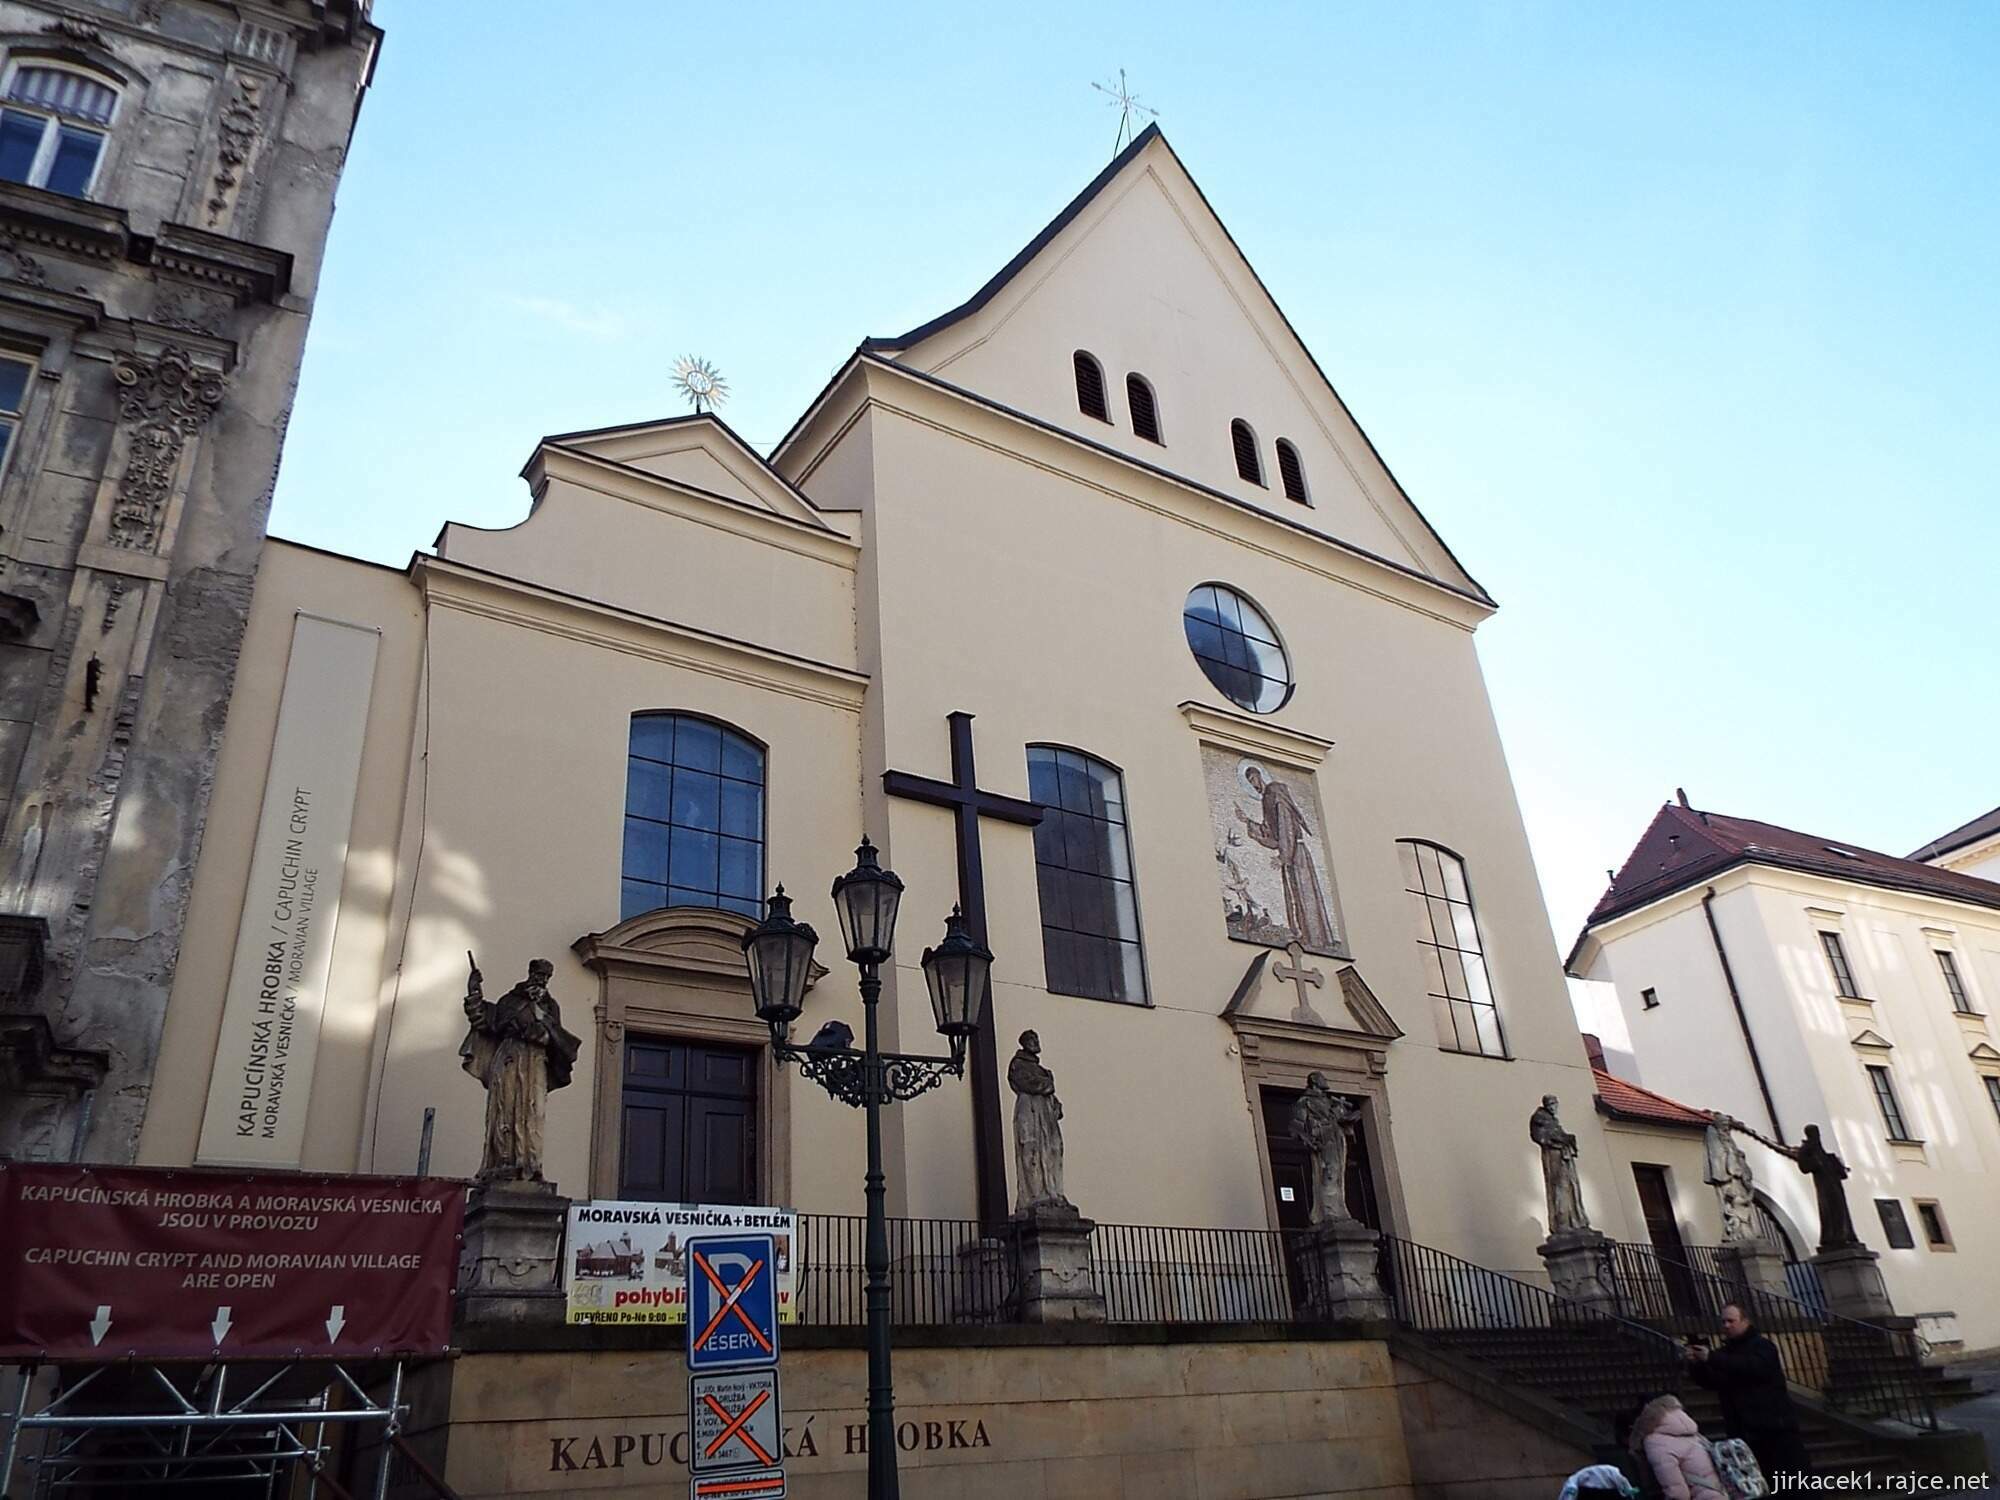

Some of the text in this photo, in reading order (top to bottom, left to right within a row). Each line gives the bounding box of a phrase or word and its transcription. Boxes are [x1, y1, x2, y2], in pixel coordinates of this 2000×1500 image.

[237, 1022, 272, 1138] KAPUCÍNSKÁ
[258, 940, 287, 1014] HROBKA
[274, 839, 303, 921] CAPUCHIN
[290, 786, 312, 834] CRYPT
[262, 1062, 286, 1138] MORAVSKÁ
[276, 995, 297, 1059] VESNIČKA
[288, 918, 309, 982] MORAVIAN
[300, 867, 318, 913] VILLAGE
[20, 1184, 443, 1213] KAPUCÍNSKÁ HROBKA A MORAVSKÁ VESNIČKA
[158, 1213, 319, 1231] JSOU V PROVOZU
[578, 1207, 661, 1225] MORAVSKÁ
[25, 1247, 421, 1270] CAPUCHIN CRYPT AND MORAVIAN VILLAGE
[181, 1272, 276, 1288] ARE OPEN
[615, 1285, 687, 1308] pohybli
[574, 1310, 619, 1323] OTEVŘENO
[701, 1328, 769, 1352] ÉSERV
[549, 1416, 992, 1471] KAPUCKÁ HOBKA
